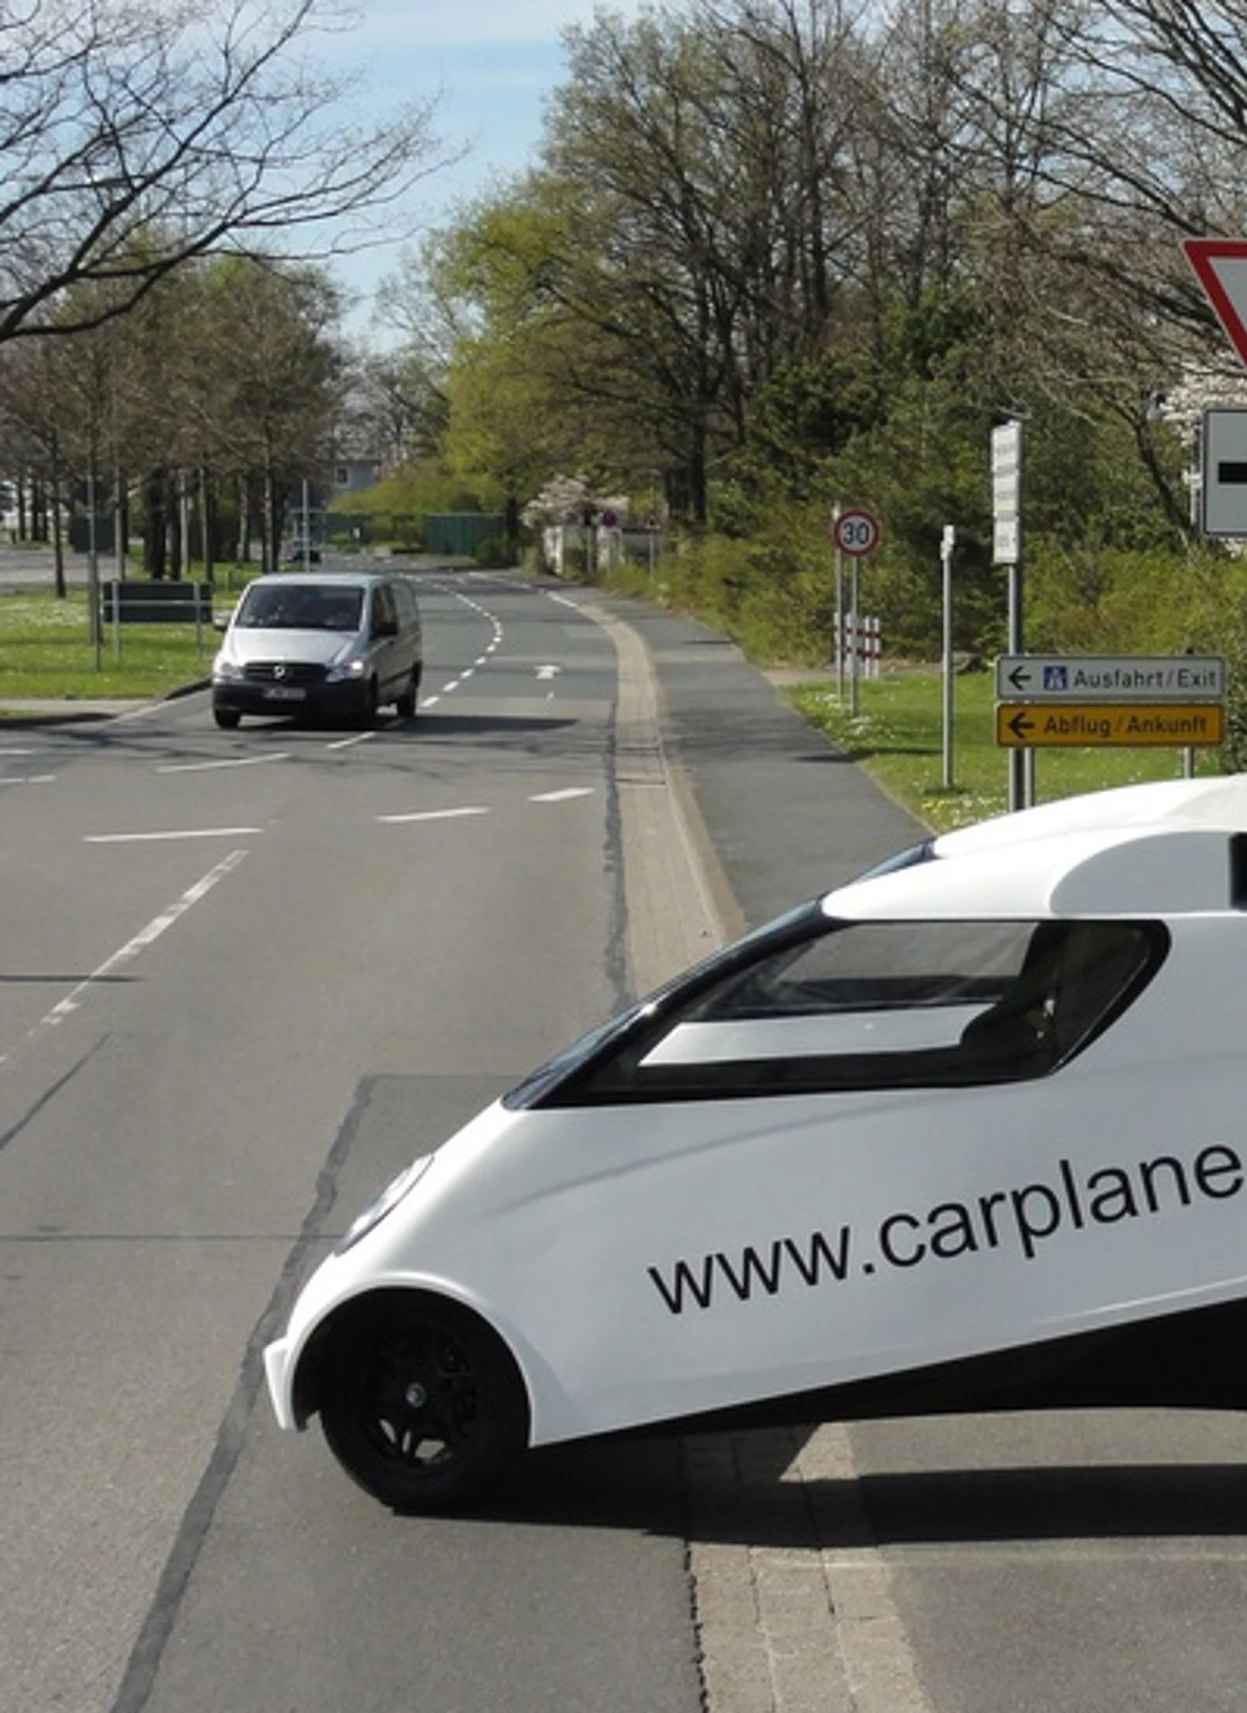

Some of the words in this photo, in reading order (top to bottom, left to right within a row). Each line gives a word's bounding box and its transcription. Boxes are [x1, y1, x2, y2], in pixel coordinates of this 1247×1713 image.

[843, 522, 869, 545] 30
[1043, 713, 1111, 737] Abflug
[1127, 713, 1208, 734] Ankunft
